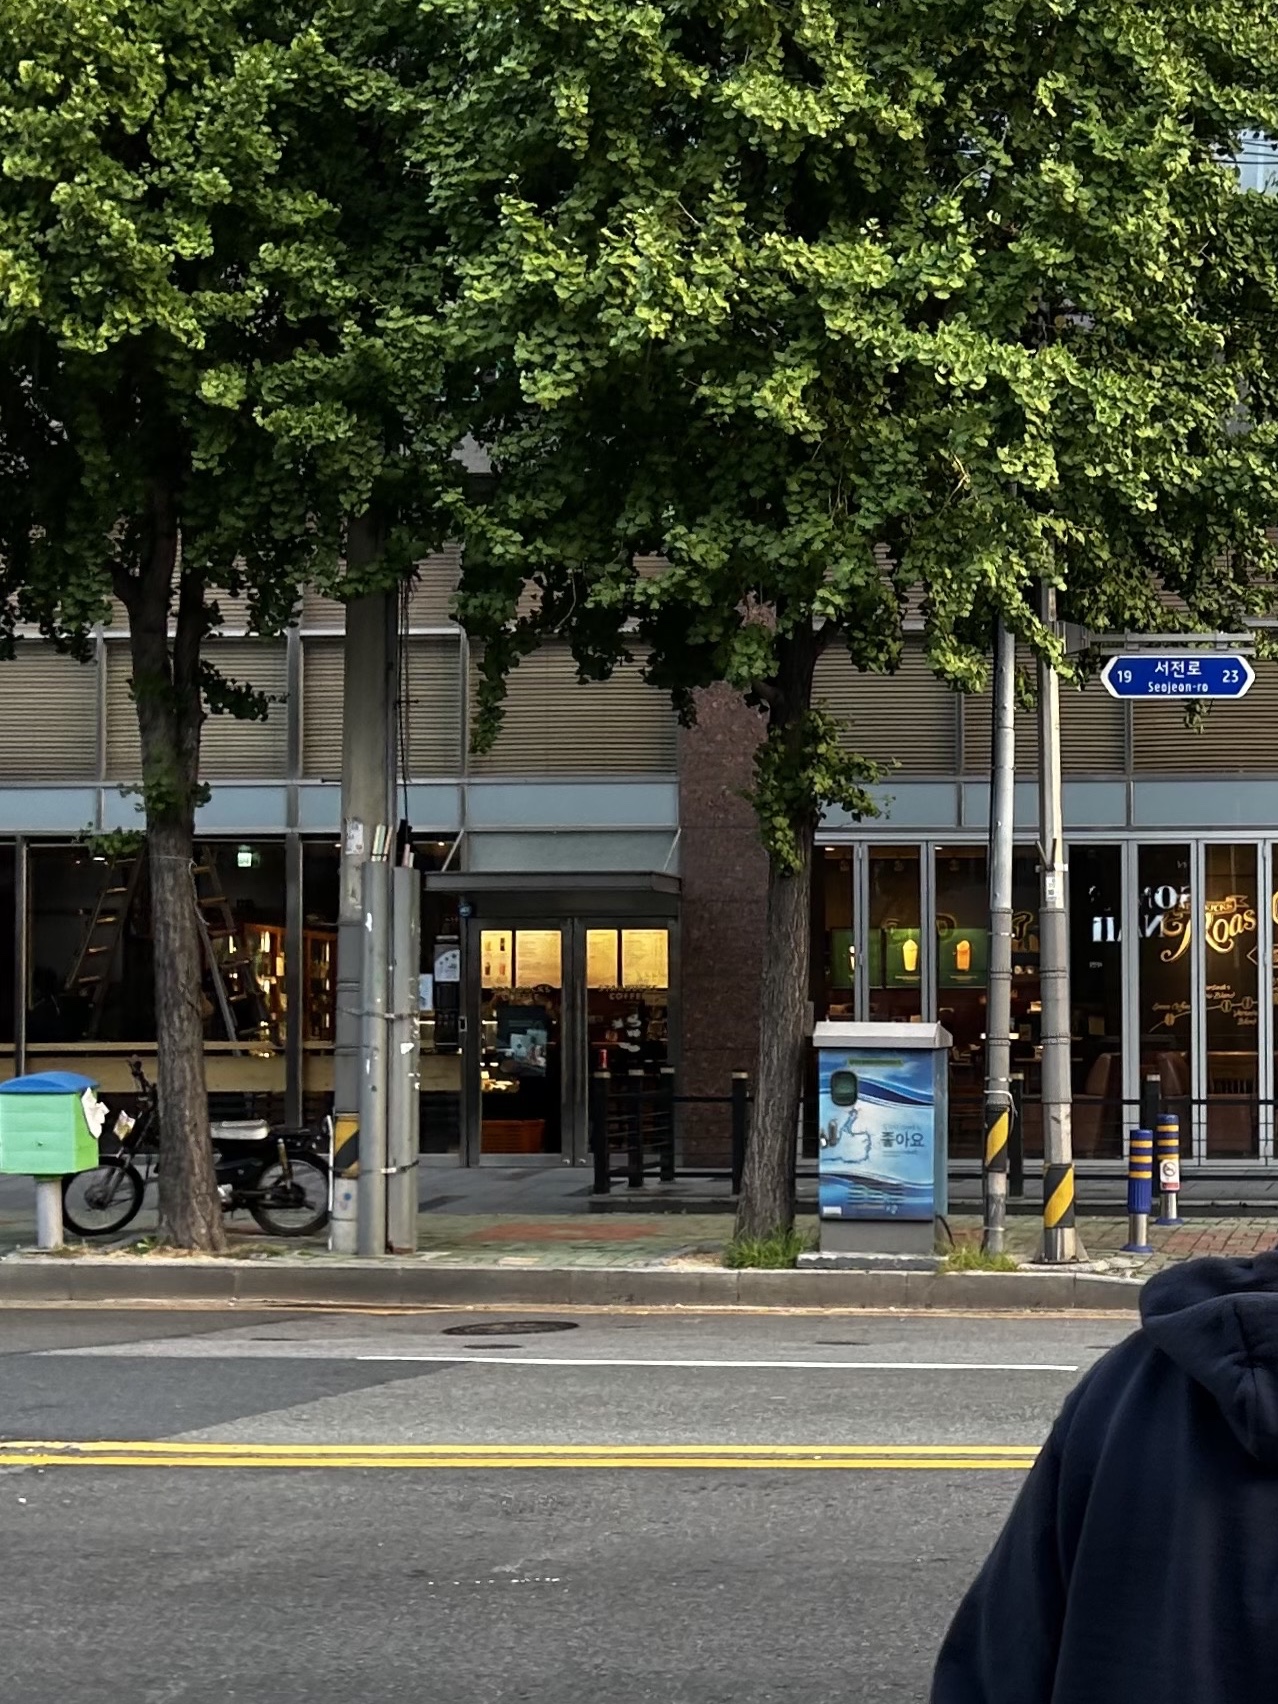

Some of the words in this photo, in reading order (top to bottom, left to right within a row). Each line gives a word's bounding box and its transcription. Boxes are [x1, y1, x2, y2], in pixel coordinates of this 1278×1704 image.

[1117, 670, 1133, 684] 19
[1154, 660, 1203, 679] 서전로
[1222, 669, 1240, 684] 23
[1148, 681, 1209, 694] Seojeon-ro
[880, 1130, 926, 1148] 좋아요
